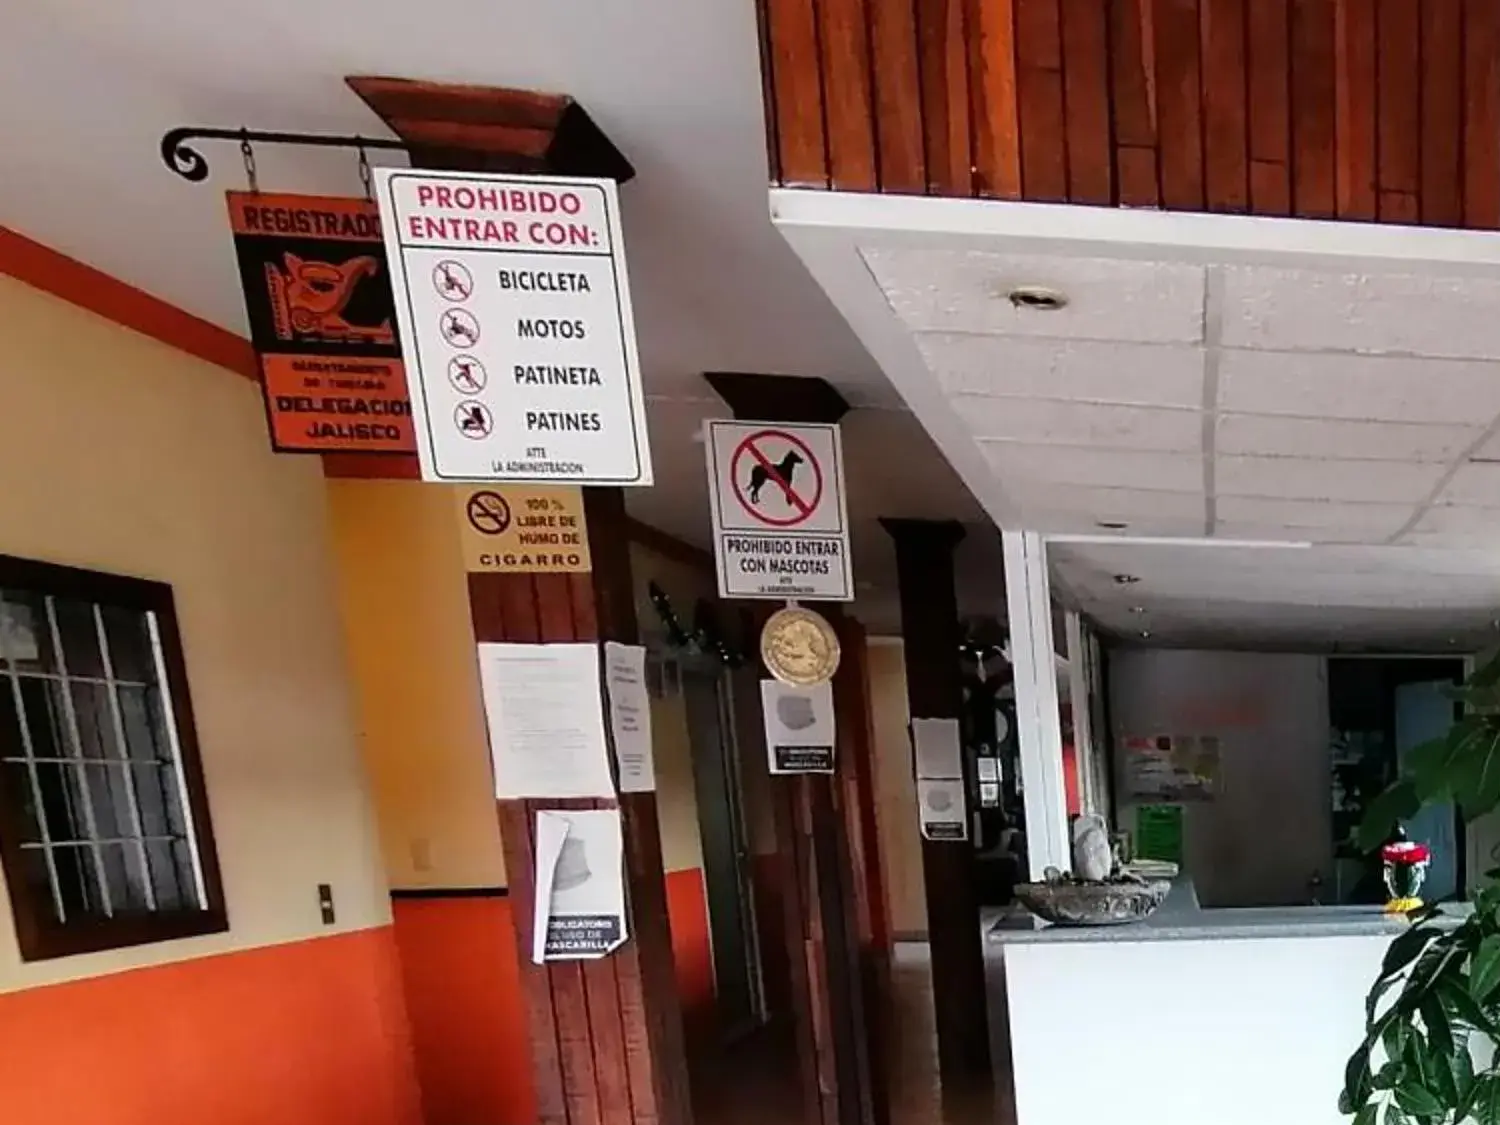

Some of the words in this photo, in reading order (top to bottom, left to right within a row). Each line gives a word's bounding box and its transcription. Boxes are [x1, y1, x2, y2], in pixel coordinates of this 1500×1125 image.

[417, 185, 581, 215] PROHIBIDO
[408, 216, 519, 243] ENTRAR
[528, 222, 599, 246] CON:
[499, 270, 591, 292] BICICLETA
[517, 319, 586, 340] MOTOS
[513, 365, 603, 386] PATINETA
[306, 422, 401, 440] JALISCO
[526, 412, 601, 432] PATINES
[516, 515, 556, 527] LIBRE
[559, 515, 577, 527] DE
[519, 533, 559, 545] HUMO
[562, 533, 580, 545] DE
[727, 539, 793, 555] PROHIBIDO
[795, 540, 839, 556] ENTRAR
[479, 553, 581, 566] CIGARRO
[740, 558, 767, 573] CON
[769, 559, 830, 575] MASCOTAS
